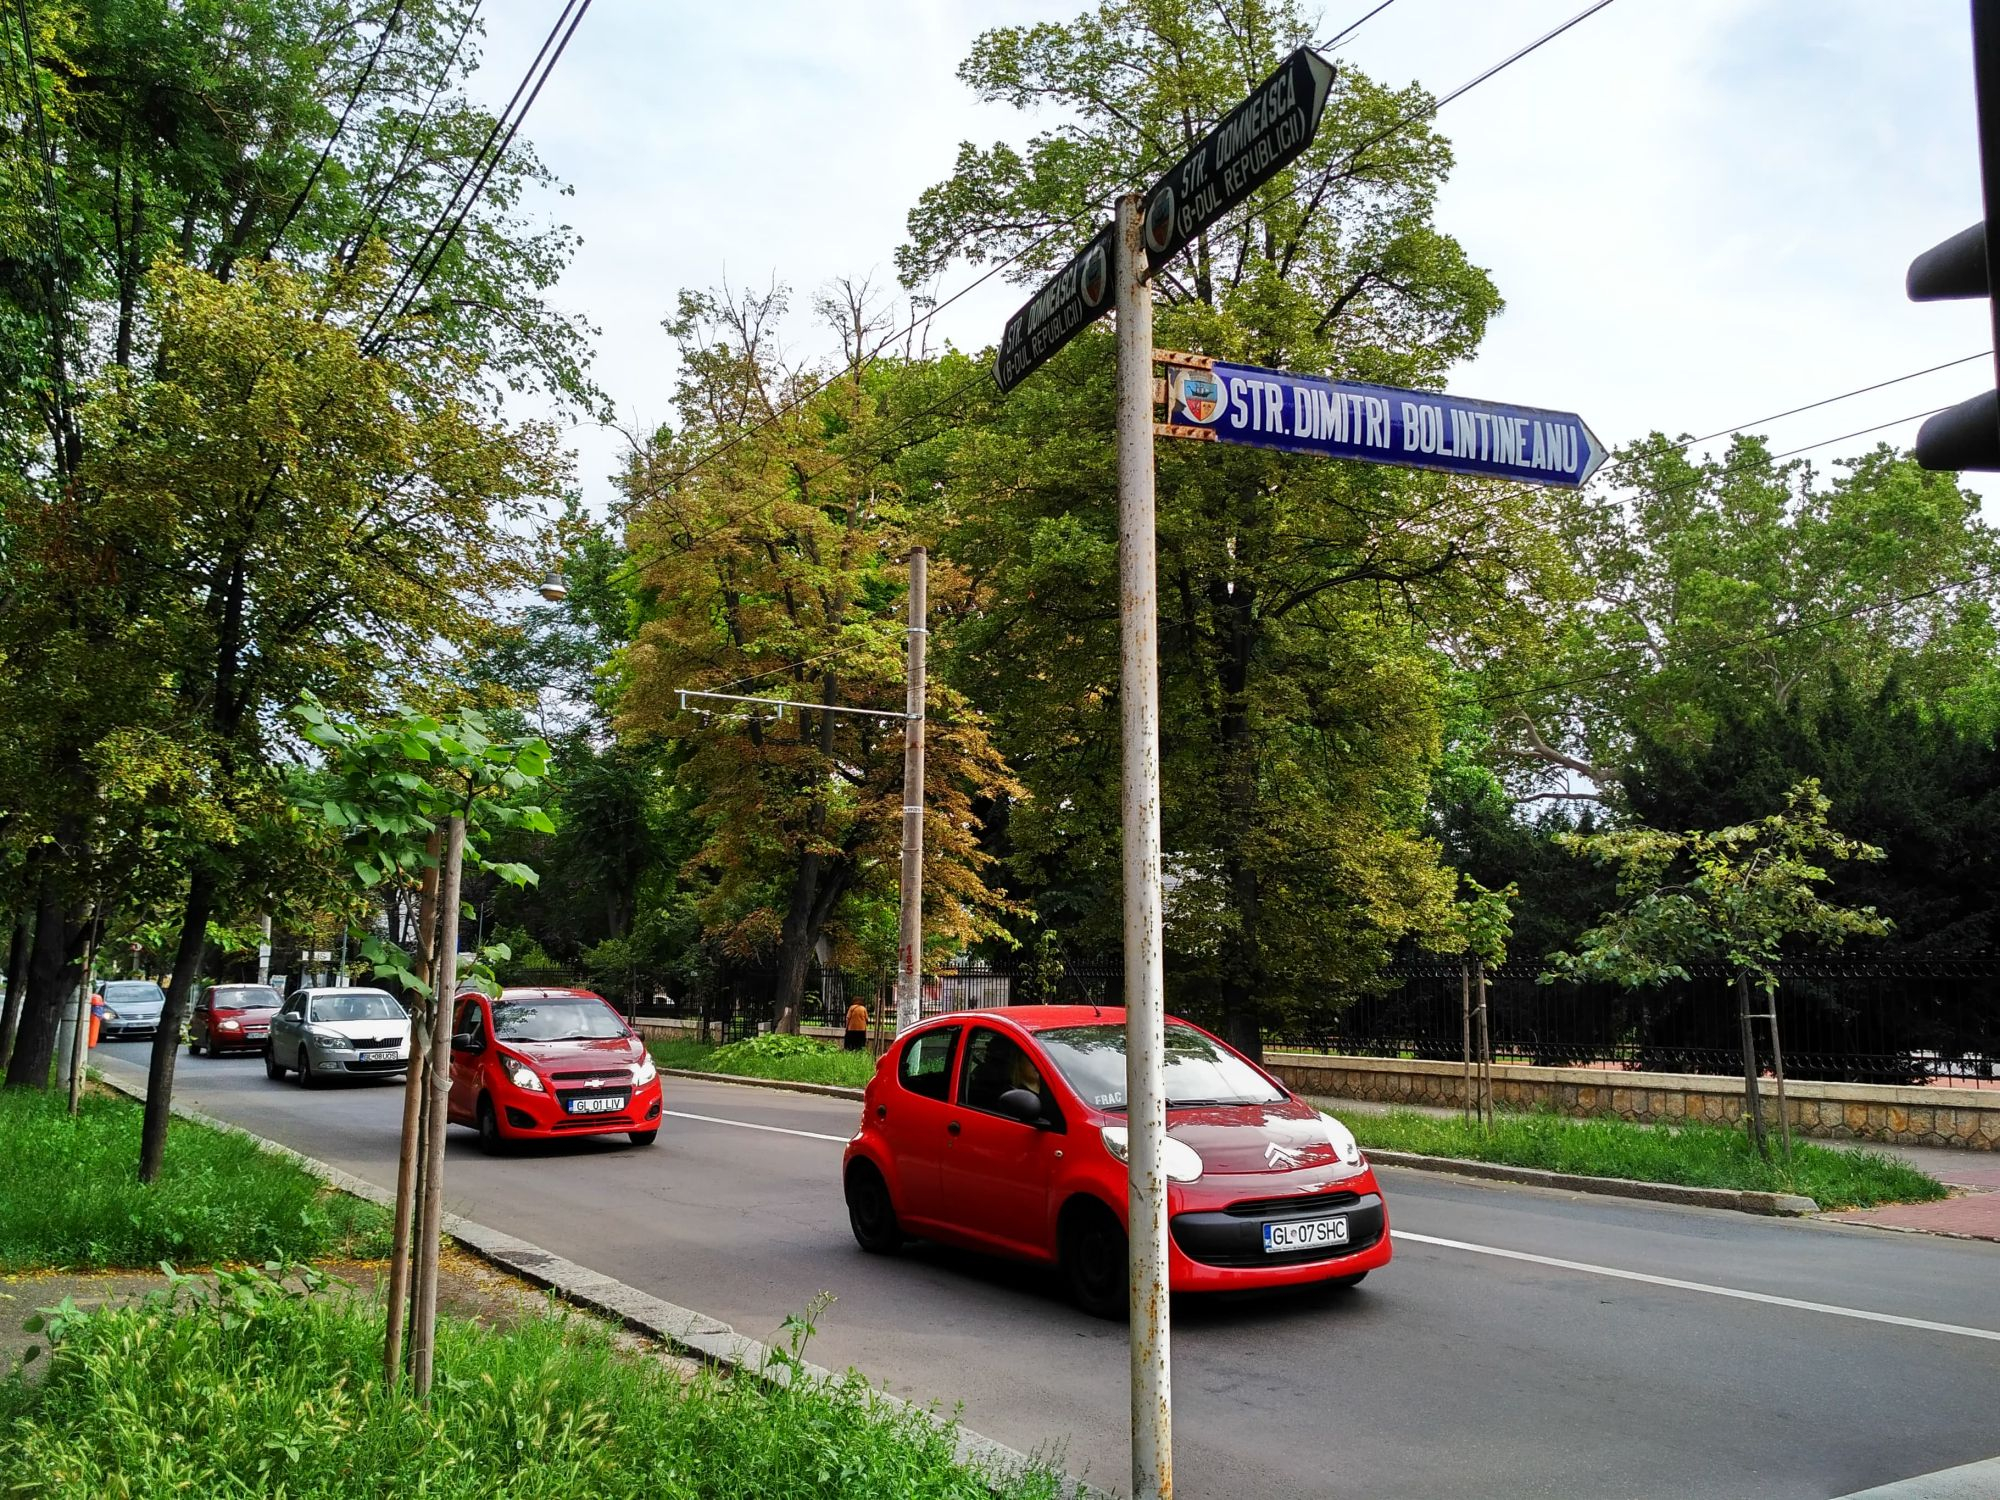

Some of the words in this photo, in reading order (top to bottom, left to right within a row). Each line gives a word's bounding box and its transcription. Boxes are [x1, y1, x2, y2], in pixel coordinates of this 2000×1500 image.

[1177, 183, 1222, 239] (B-DUL
[1223, 106, 1306, 197] REPUBLICII)
[1181, 147, 1208, 199] STR.
[1002, 349, 1032, 386] (B-DUL
[1031, 295, 1083, 359] REPUBLICII)
[1006, 316, 1023, 355] STR.
[1229, 377, 1290, 435] STR.
[1293, 386, 1391, 449] DIMITRI
[1401, 401, 1578, 474] BOLINTINEANU
[1273, 1227, 1293, 1245] GL
[1298, 1224, 1315, 1242] 07
[1316, 1221, 1345, 1240] SHC
